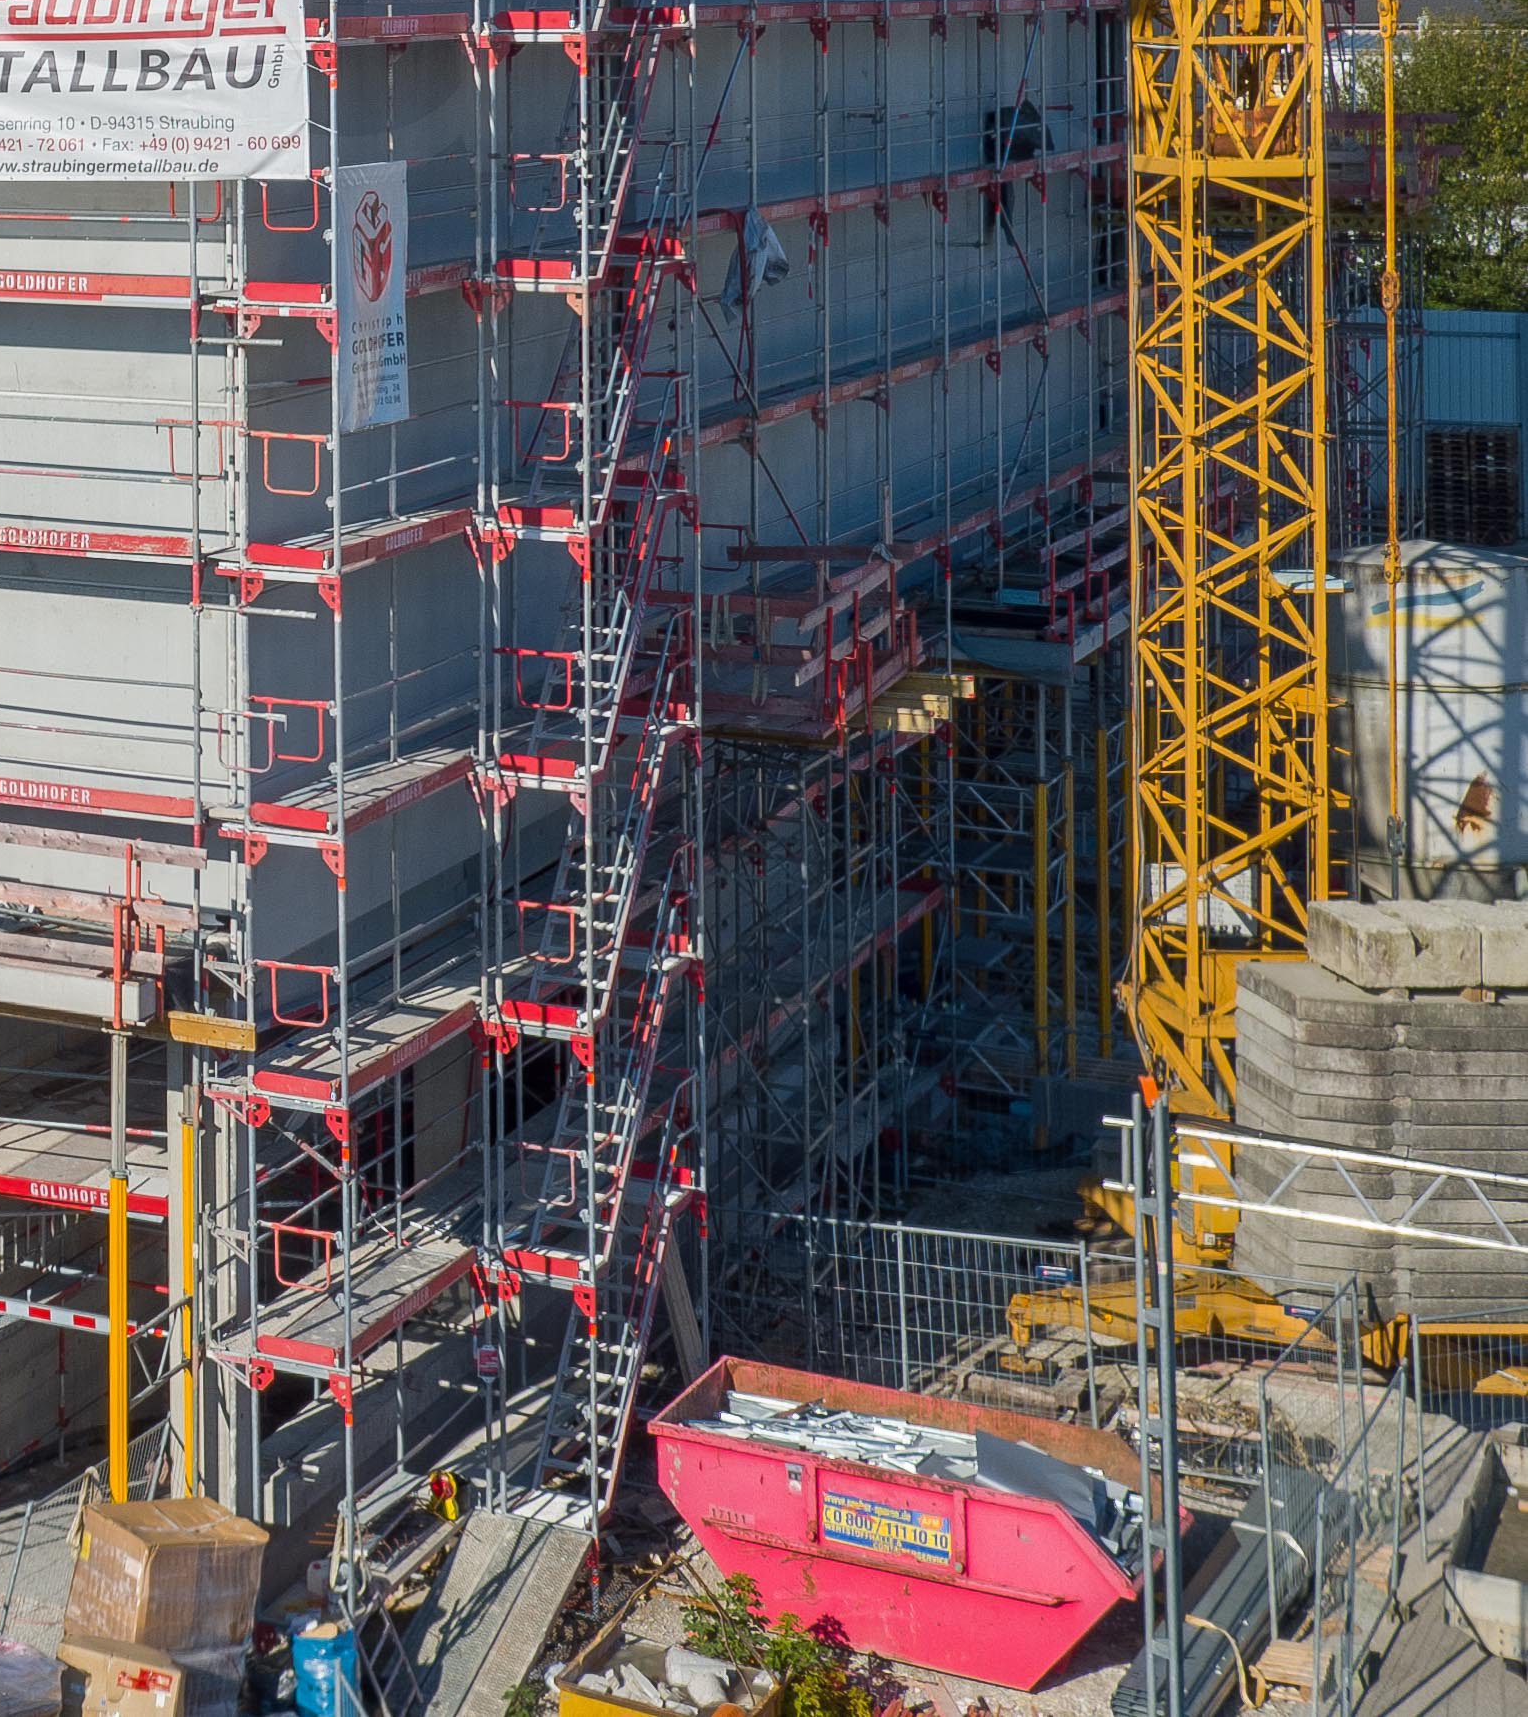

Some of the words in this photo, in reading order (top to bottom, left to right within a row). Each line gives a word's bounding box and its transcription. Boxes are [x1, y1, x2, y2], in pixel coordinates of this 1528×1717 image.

[267, 43, 285, 89] GmbH
[57, 116, 75, 130] 10
[90, 115, 154, 130] D-94315
[159, 115, 235, 132] Straubing
[102, 138, 134, 152] Fax:
[139, 137, 167, 151] +49
[171, 136, 189, 154] (0)
[193, 136, 230, 151] 9421
[0, 780, 90, 803] GOLDHOFER
[29, 1182, 108, 1206] GOLDHOFE
